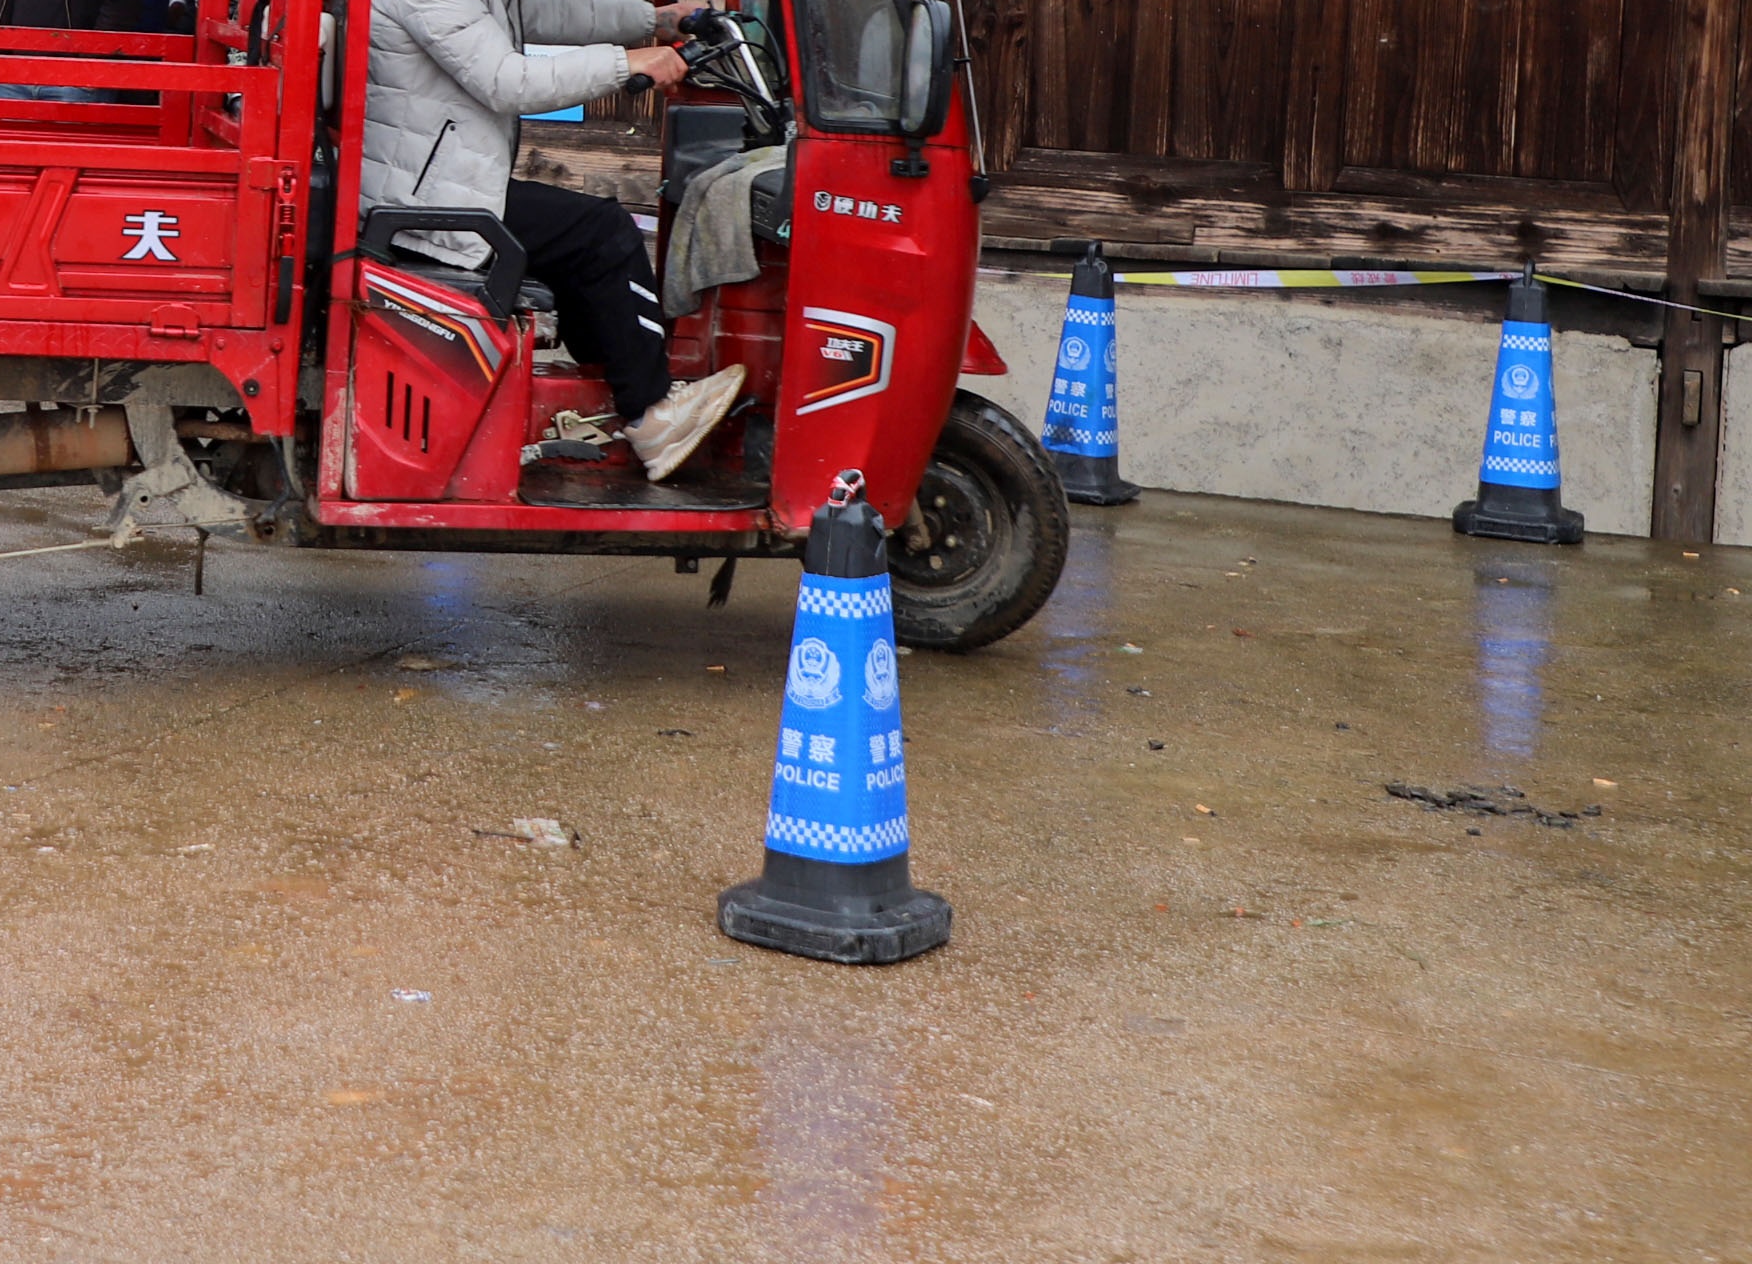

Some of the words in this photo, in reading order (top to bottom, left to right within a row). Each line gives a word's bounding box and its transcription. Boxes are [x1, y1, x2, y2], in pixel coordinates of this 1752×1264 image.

[833, 194, 903, 224] 硬功夫
[1053, 377, 1086, 398] 警察
[1048, 398, 1089, 419] POLICE
[1500, 408, 1537, 427] 警察
[1493, 430, 1542, 449] POLICE
[782, 727, 836, 764] 警察
[869, 729, 902, 764] 警察
[775, 761, 841, 792] POLICE
